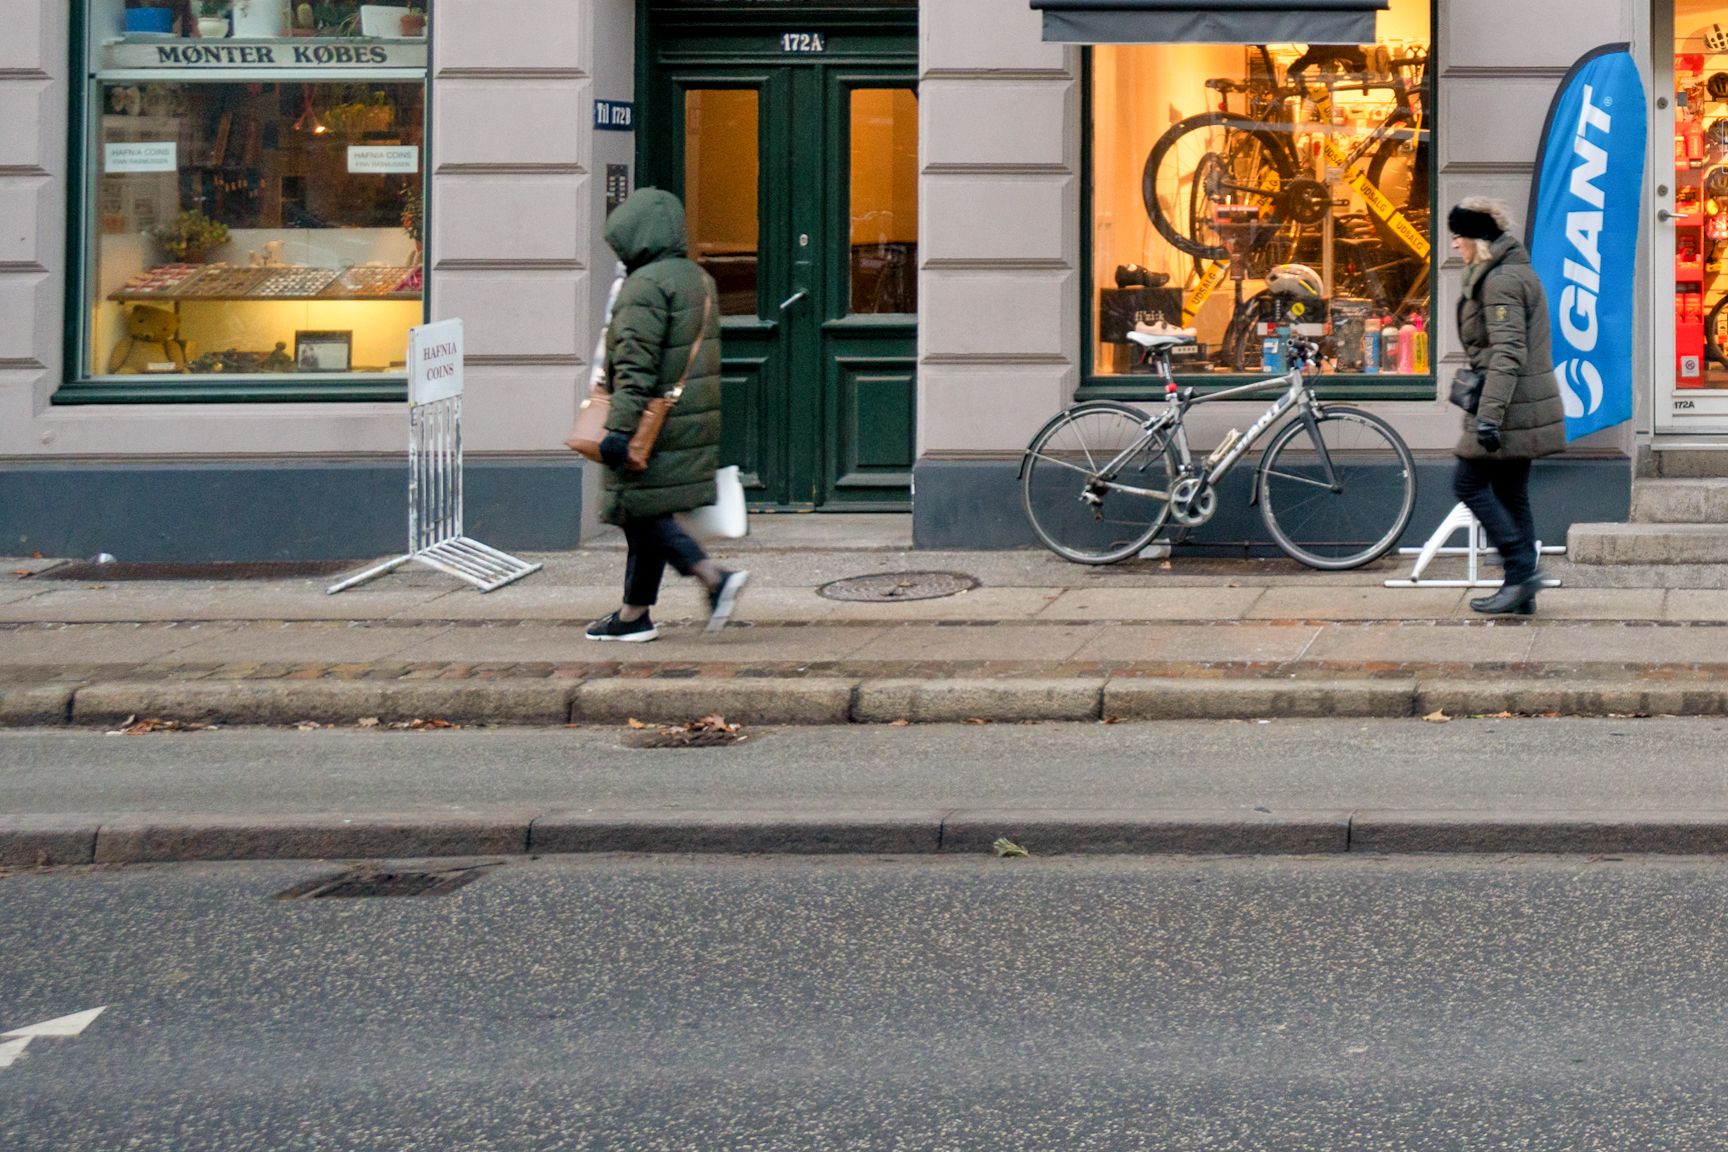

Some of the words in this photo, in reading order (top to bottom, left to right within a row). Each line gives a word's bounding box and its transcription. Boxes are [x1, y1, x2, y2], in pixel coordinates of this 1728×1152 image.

[782, 32, 823, 51] 172A
[157, 44, 275, 66] MØNTER
[293, 44, 388, 65] KØBES
[597, 102, 610, 124] Til
[611, 106, 632, 126] 172B
[1360, 183, 1388, 213] UDSALG
[1559, 84, 1611, 352] GIANT
[1396, 221, 1424, 250] UDSALG
[1192, 272, 1217, 305] UDSALG
[423, 342, 457, 360] HAFNIA
[426, 363, 455, 381] COINS
[1674, 400, 1695, 409] 172A
